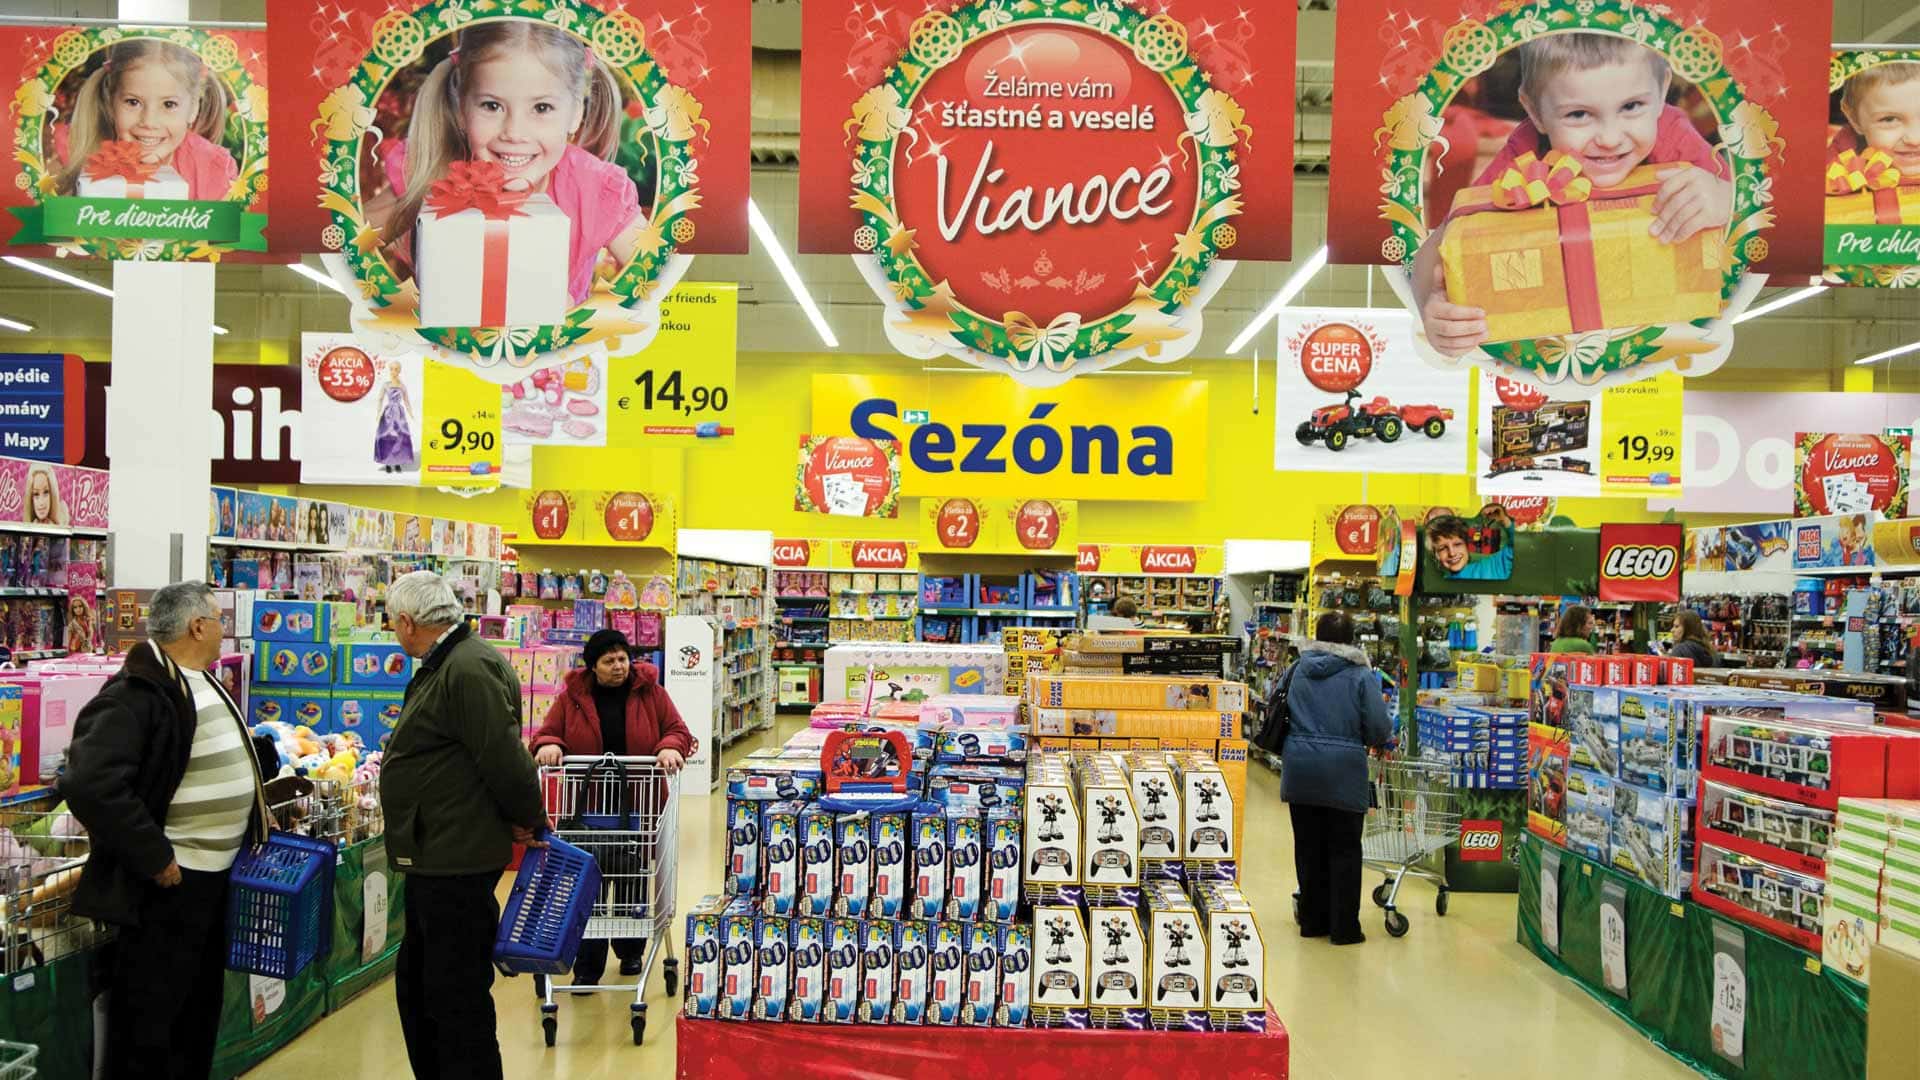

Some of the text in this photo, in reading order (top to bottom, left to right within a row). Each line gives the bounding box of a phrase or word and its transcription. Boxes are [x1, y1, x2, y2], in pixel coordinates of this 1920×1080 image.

[983, 71, 1113, 99] Želáme vám
[941, 101, 1155, 130] šťastné a veselé
[937, 141, 1173, 242] Vianoce
[76, 205, 212, 230] Pre dievčatká
[1837, 232, 1874, 254] Pre
[675, 292, 717, 304] friends
[659, 320, 691, 331] nkou
[1310, 342, 1361, 356] SUPER
[328, 357, 364, 369] AKCIA
[1310, 357, 1361, 374] CENA
[635, 370, 729, 416] 14,90
[4, 432, 50, 450] Mapy
[441, 418, 495, 454] 9,90
[849, 397, 1174, 475] Sezóna
[824, 449, 874, 471] Vianoce
[1618, 435, 1675, 464] 19,99
[1824, 448, 1880, 472] Vianoce
[773, 546, 806, 561] KCIA
[1604, 547, 1676, 578] LEGO
[1220, 748, 1247, 756] GIANT
[1463, 832, 1500, 848] LEGO
